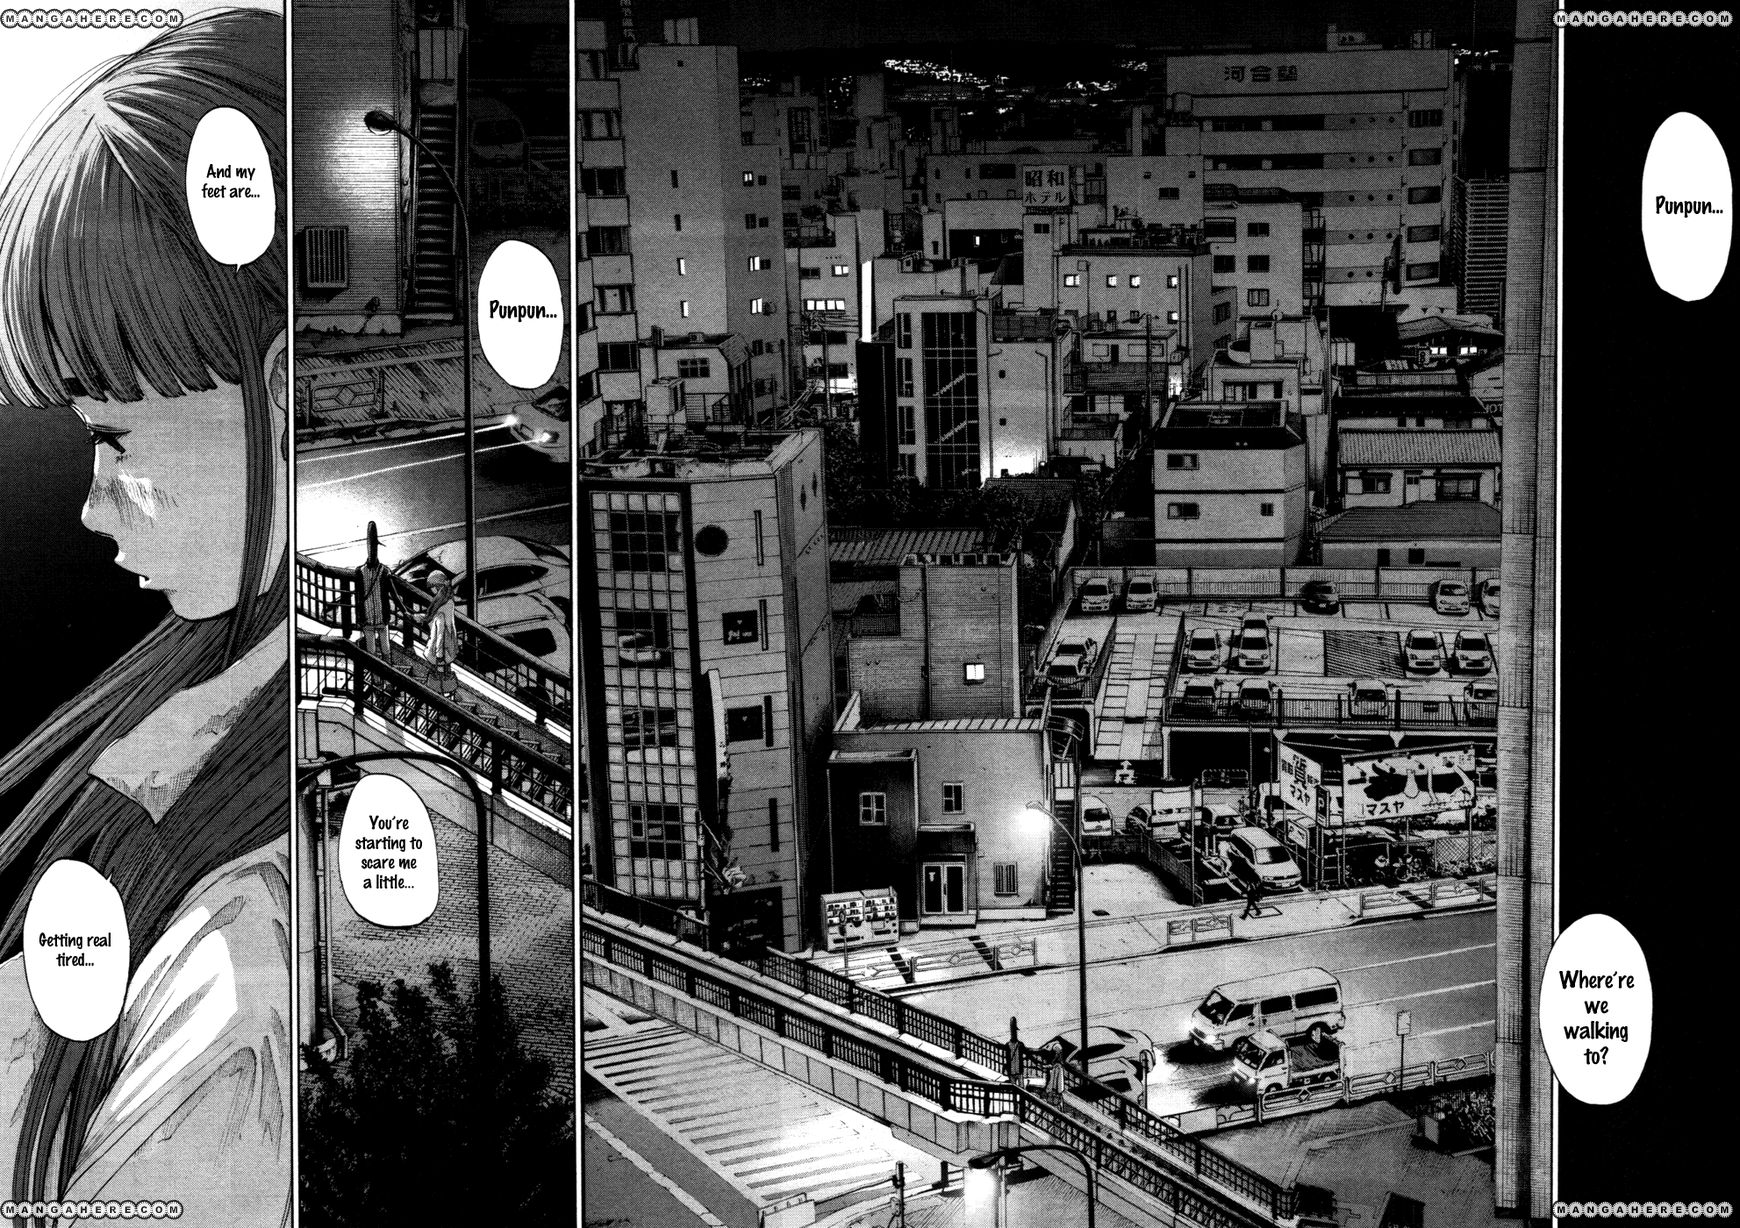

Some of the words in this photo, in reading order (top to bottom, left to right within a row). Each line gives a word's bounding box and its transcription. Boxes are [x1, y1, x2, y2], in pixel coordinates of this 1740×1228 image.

[1223, 65, 1298, 83] 河合塾
[206, 163, 232, 179] And
[235, 167, 256, 181] my
[1025, 168, 1065, 188] 昭和
[201, 182, 227, 199] feet
[229, 187, 261, 199] are...
[1024, 190, 1066, 204] ホテル
[1655, 195, 1724, 219] Punpun...
[489, 299, 558, 323] Punpun...
[1289, 783, 1311, 807] マスヤ
[1366, 801, 1405, 817] マスヤ
[368, 815, 410, 831] You're
[355, 835, 407, 853] starting
[409, 836, 423, 850] to
[360, 858, 396, 870] scare
[398, 858, 418, 870] me
[362, 878, 372, 890] a
[375, 873, 415, 890] little...
[38, 931, 83, 950] Getting
[86, 932, 112, 948] real
[55, 952, 95, 967] tired...
[1558, 969, 1635, 990] Where're
[1584, 1000, 1609, 1015] we
[1563, 1020, 1629, 1043] walking
[1583, 1045, 1609, 1065] to?
